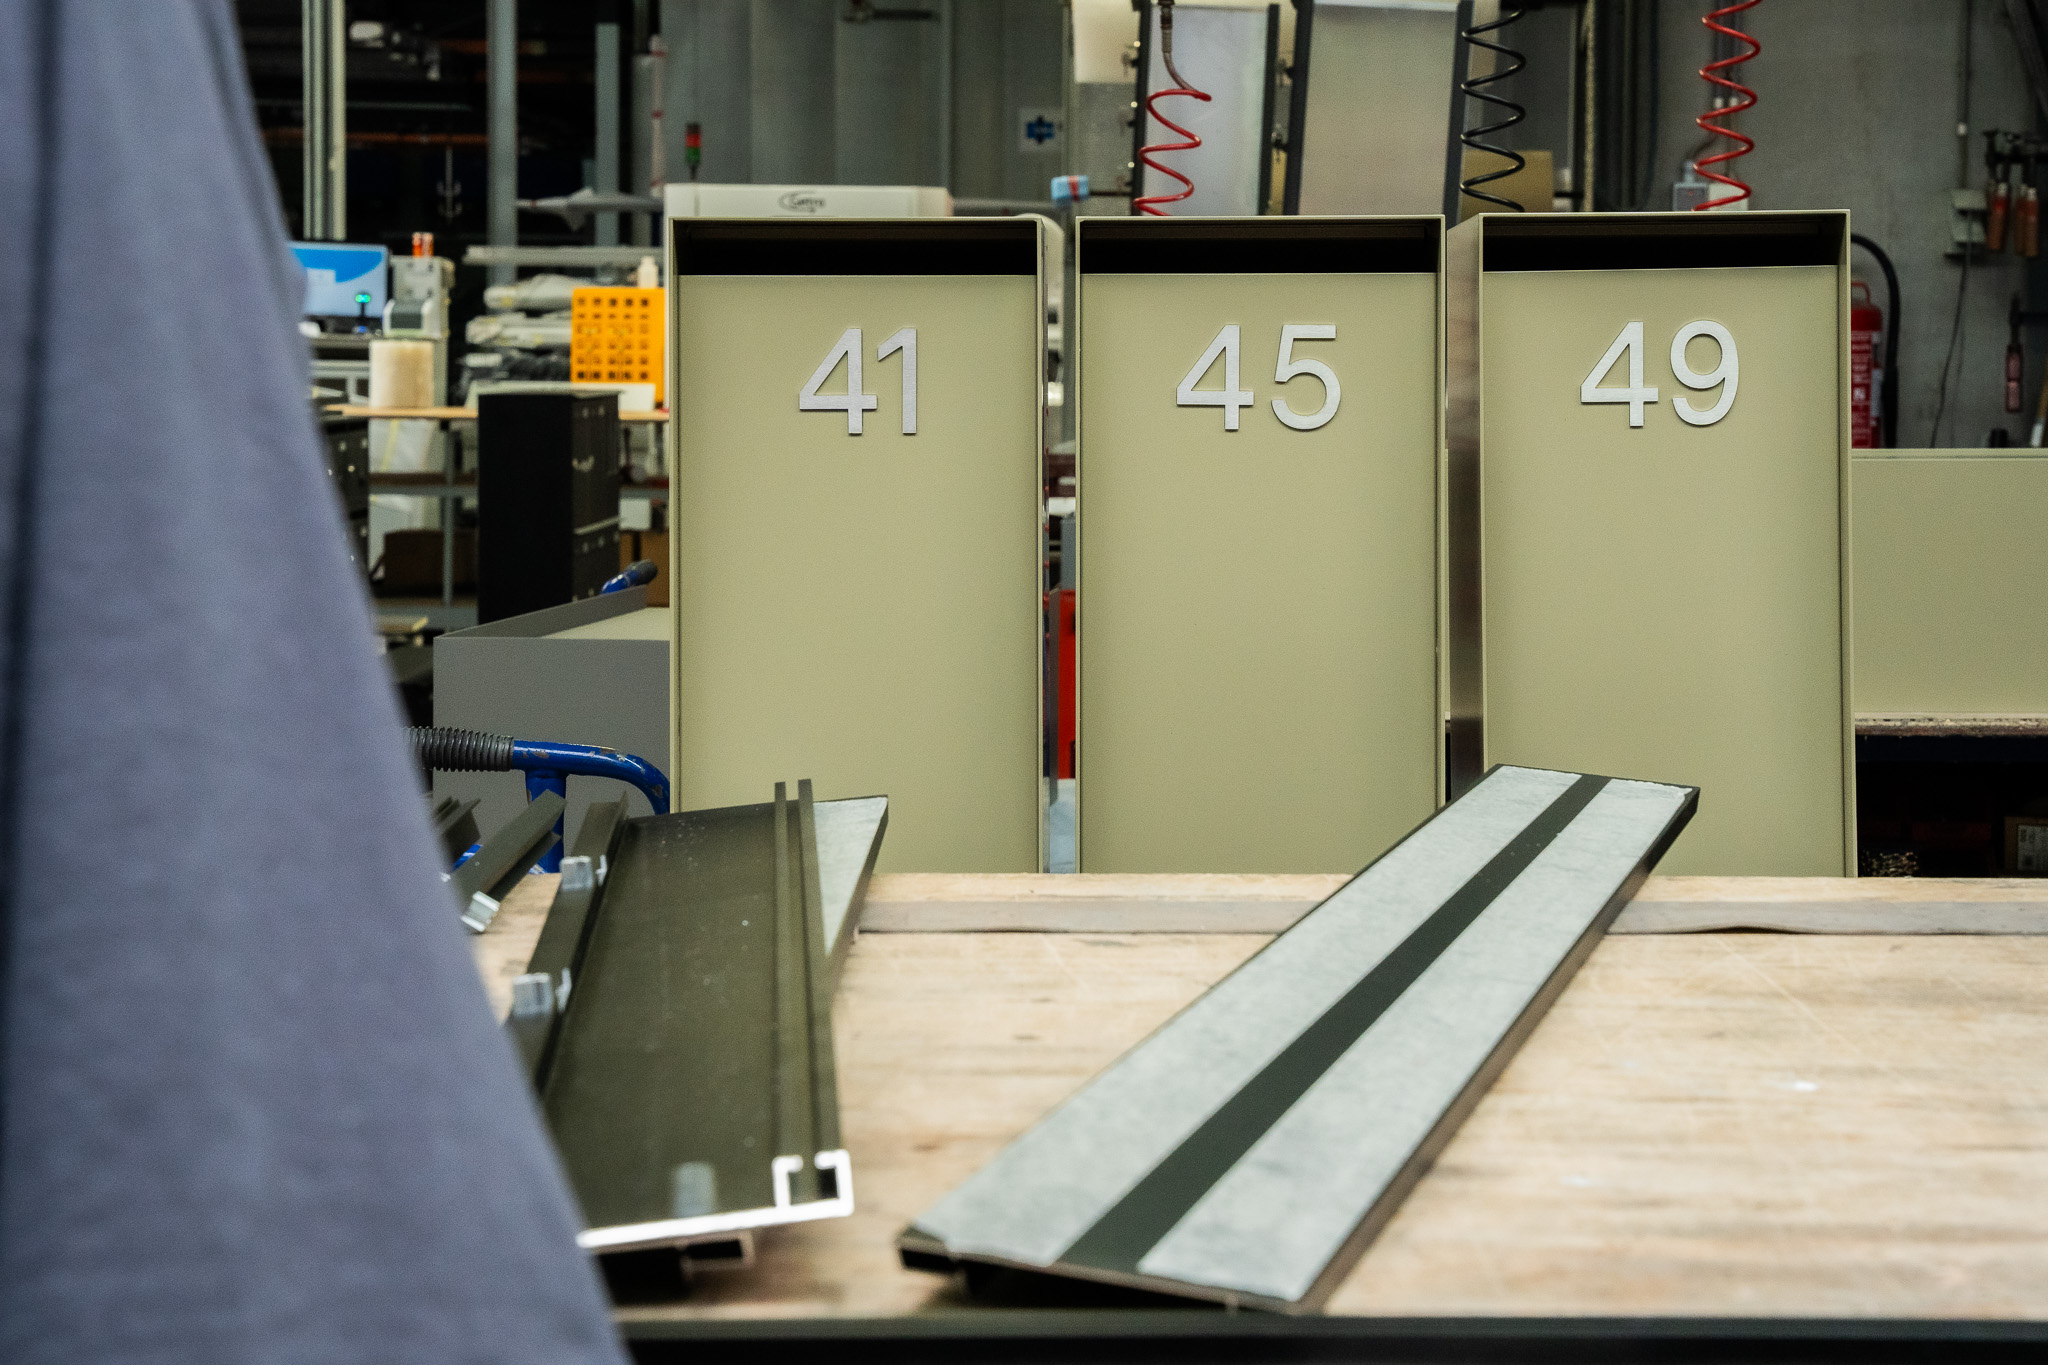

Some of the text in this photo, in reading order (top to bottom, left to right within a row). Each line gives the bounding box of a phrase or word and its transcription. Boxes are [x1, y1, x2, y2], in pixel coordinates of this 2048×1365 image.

[798, 327, 919, 435] 41
[1176, 323, 1342, 430] 45
[1580, 320, 1741, 427] 49
